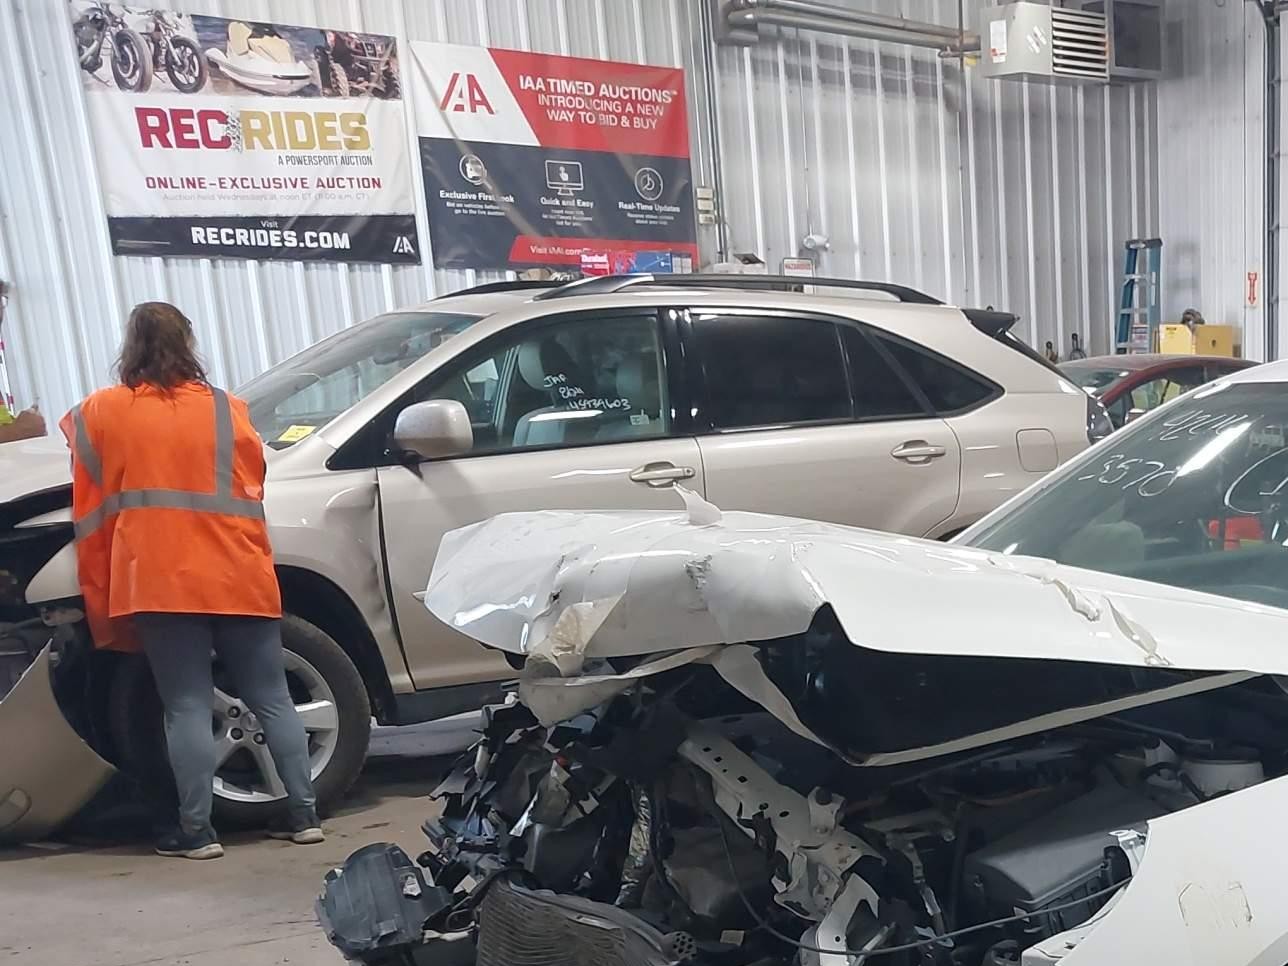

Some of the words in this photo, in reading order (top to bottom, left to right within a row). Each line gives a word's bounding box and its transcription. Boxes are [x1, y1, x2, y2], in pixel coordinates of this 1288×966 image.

[519, 75, 546, 92] IAA
[547, 78, 595, 96] TIMED
[538, 93, 622, 114] INTRODUCING
[625, 102, 634, 114] A
[637, 103, 664, 117] NEW
[547, 109, 575, 122] WAY
[578, 110, 596, 124] TO
[599, 114, 618, 127] BID
[621, 115, 630, 128] &
[634, 115, 657, 130] BUY
[278, 155, 284, 166] A
[285, 155, 338, 166] POWERSPORT
[340, 155, 373, 167] AUCTION
[145, 176, 310, 190] ONLINE-EXCLUSIVE
[316, 176, 382, 189] AUCTION
[439, 190, 477, 201] Exclusive
[540, 196, 561, 207] Quick
[577, 199, 594, 209] Easy
[618, 201, 653, 211] Real-Time
[654, 203, 681, 213] Updates
[260, 220, 278, 229] Visit
[191, 226, 351, 250] RECRIDES.COM
